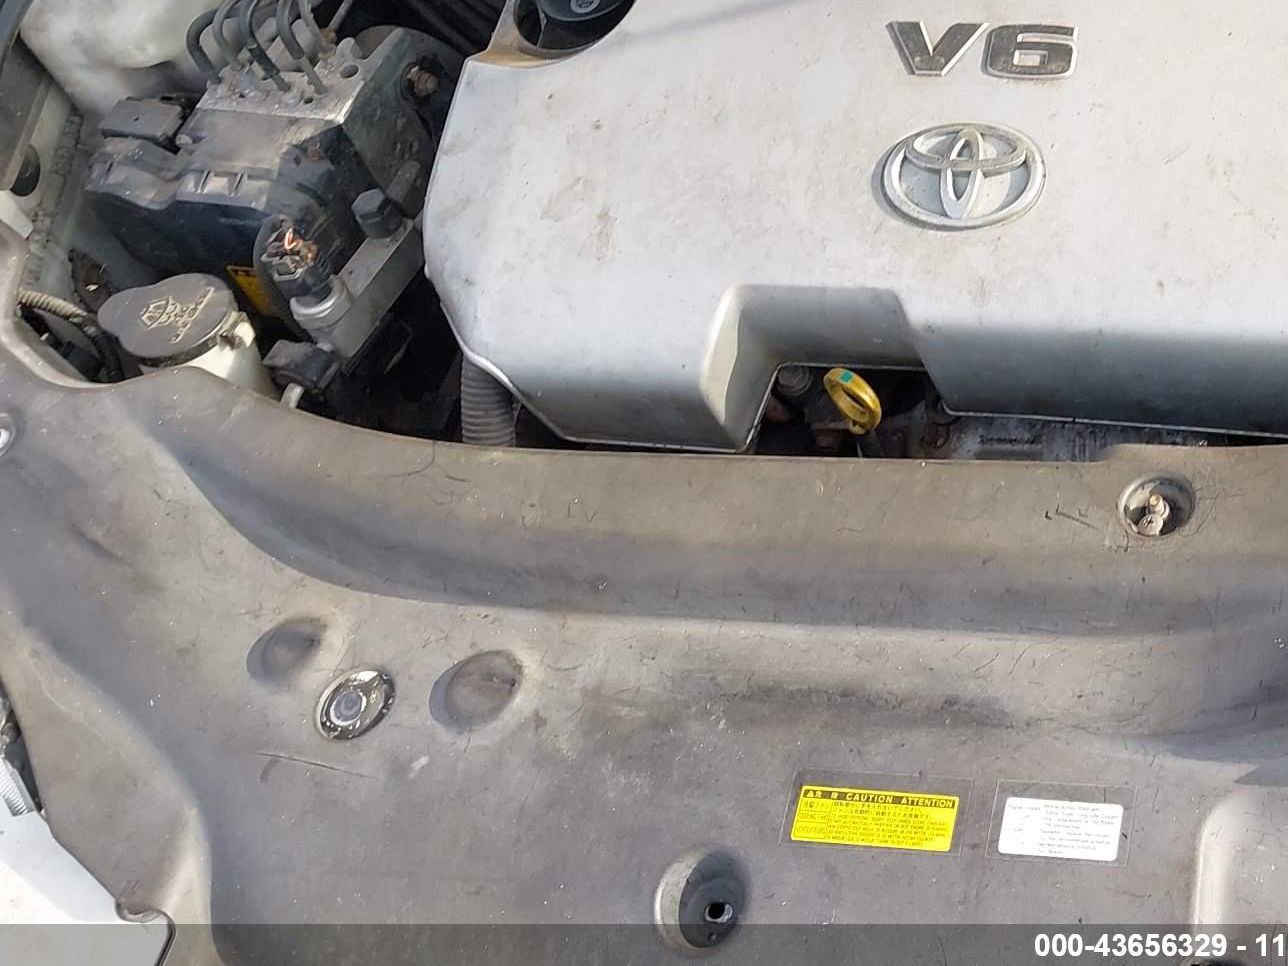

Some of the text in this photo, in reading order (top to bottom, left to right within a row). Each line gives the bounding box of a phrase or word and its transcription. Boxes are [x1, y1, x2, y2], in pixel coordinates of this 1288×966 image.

[885, 20, 1080, 81] V6
[846, 793, 893, 804] CAUTION
[901, 797, 953, 808] ATTENTION
